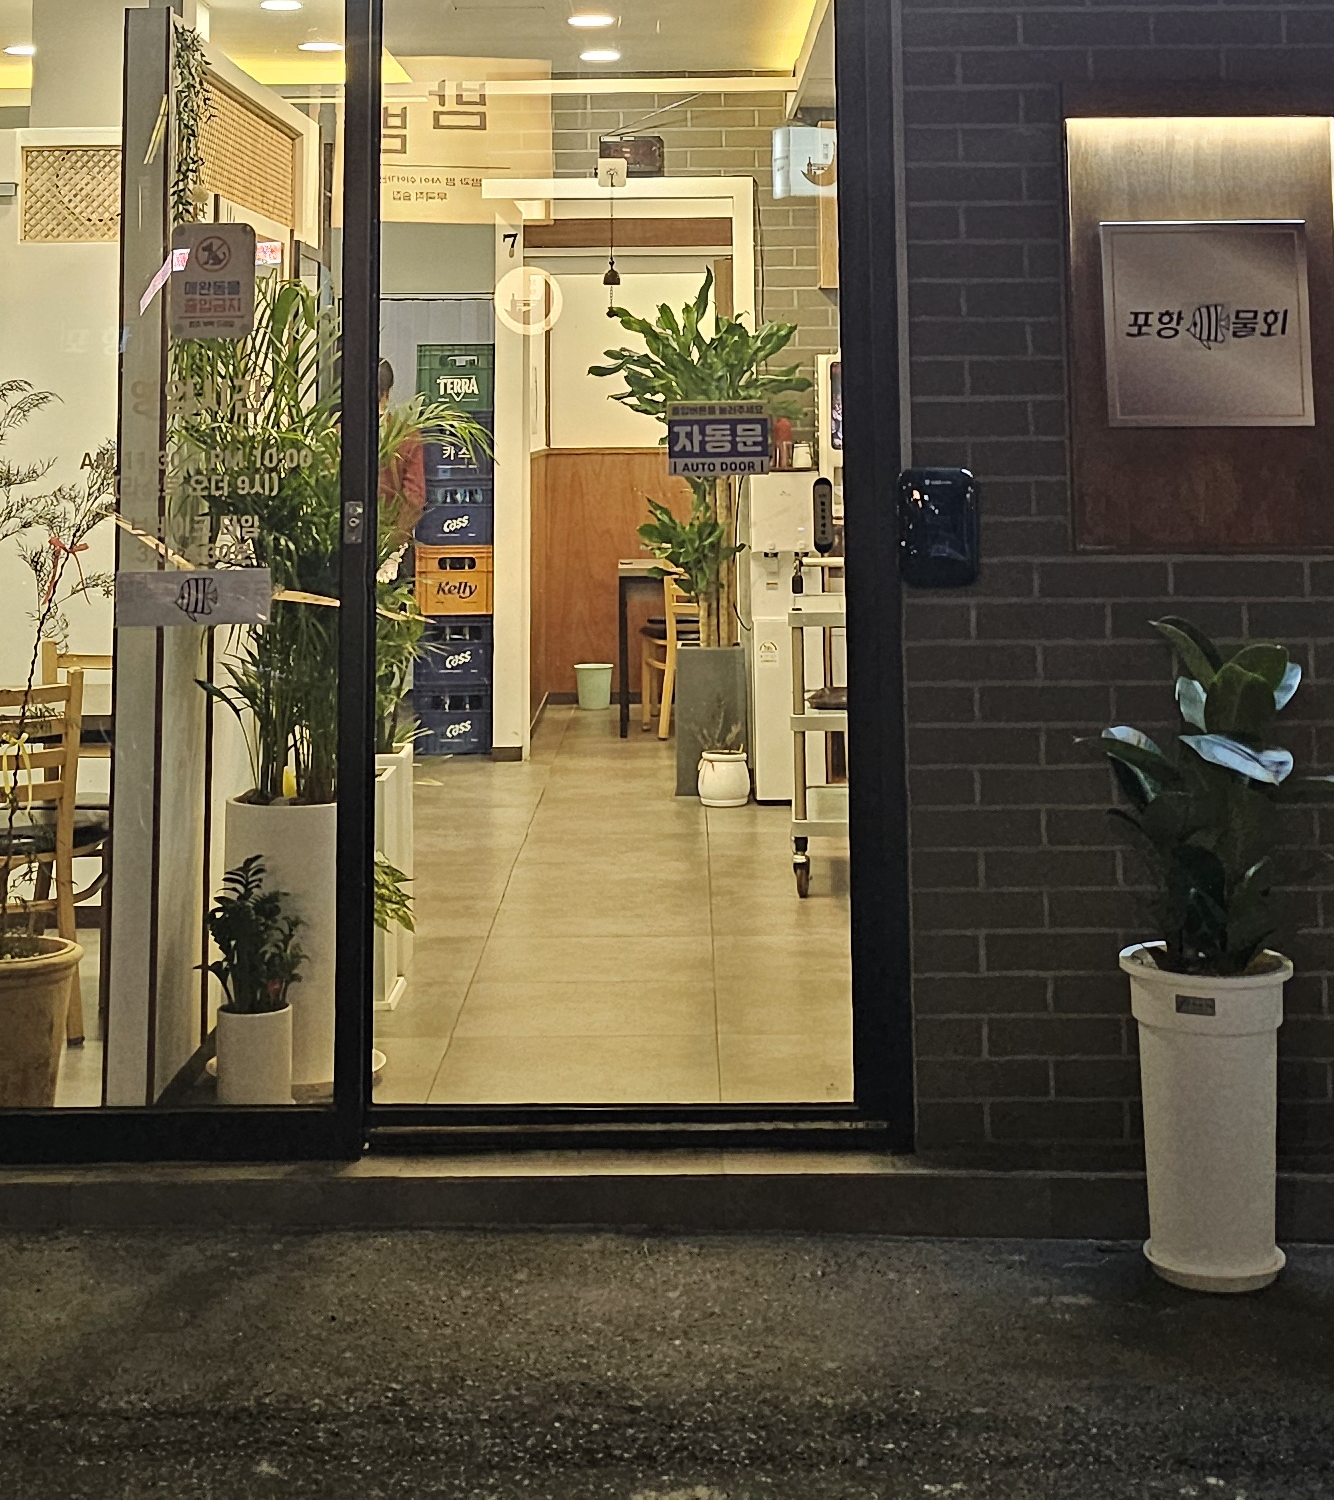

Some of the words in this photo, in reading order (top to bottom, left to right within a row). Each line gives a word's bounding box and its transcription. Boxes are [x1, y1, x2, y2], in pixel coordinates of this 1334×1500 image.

[1125, 310, 1184, 339] 포항
[1231, 308, 1288, 337] 물회
[437, 375, 479, 396] TERRA
[672, 424, 764, 453] 자동문
[442, 445, 472, 461] 카스
[681, 461, 716, 473] AUTO
[720, 461, 756, 473] DOOR
[189, 475, 230, 497] 오더
[236, 474, 280, 498] 9시)
[436, 581, 478, 599] Kelly
